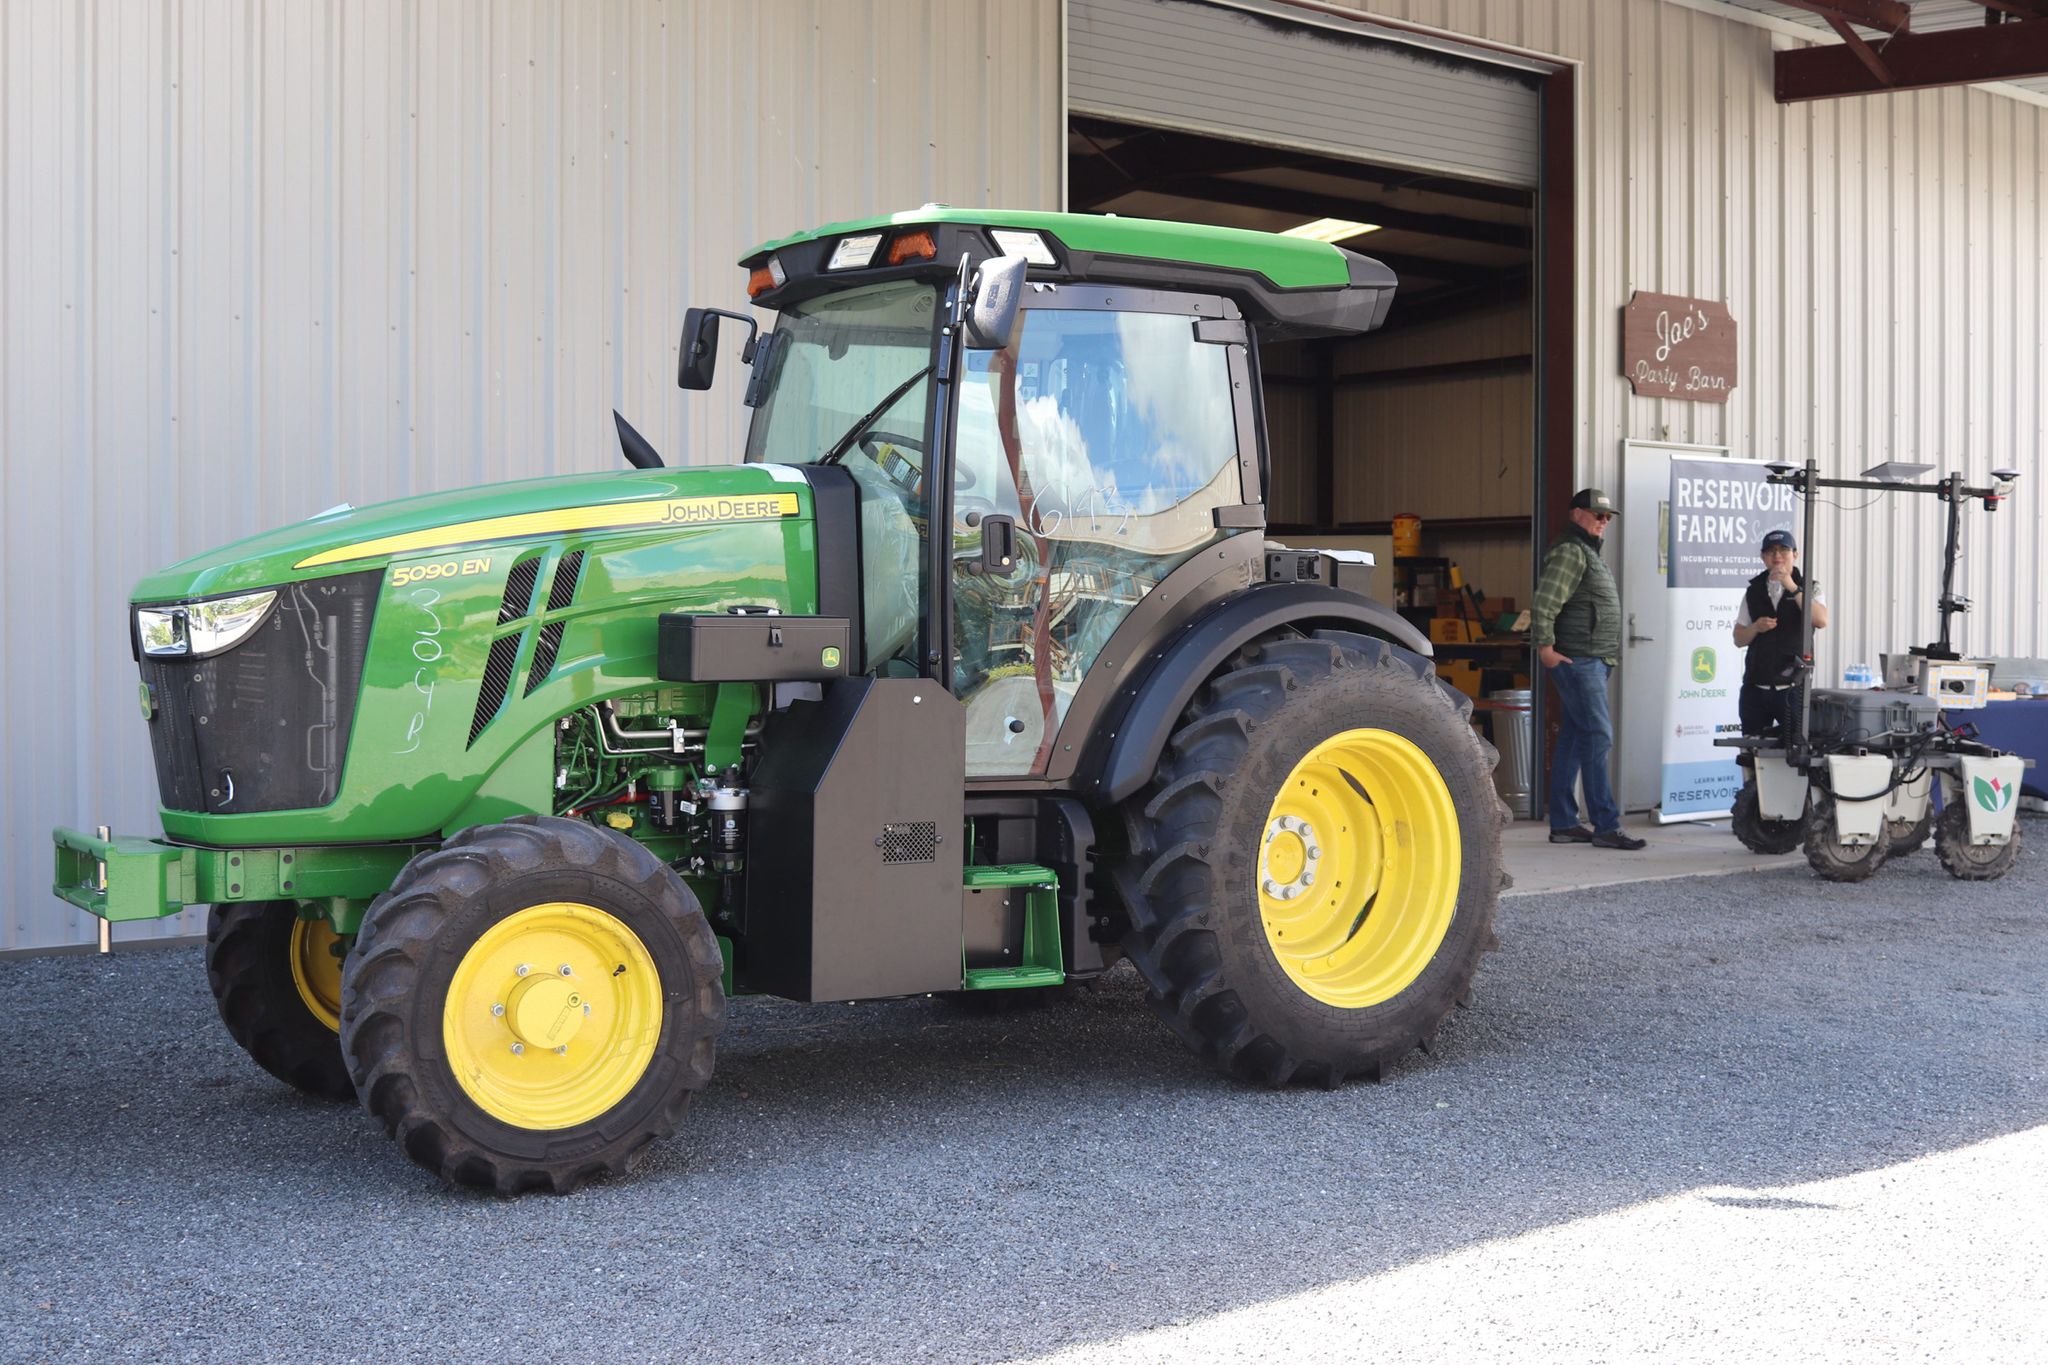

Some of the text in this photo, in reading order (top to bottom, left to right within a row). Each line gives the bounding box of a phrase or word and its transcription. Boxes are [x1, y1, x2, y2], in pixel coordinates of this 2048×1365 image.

[1656, 304, 1709, 362] Joe's
[1636, 360, 1725, 393] Party Barn
[1677, 477, 1794, 512] RESERVOIR
[662, 500, 780, 521] JOHN DEERE
[1677, 514, 1748, 544] FARMS
[391, 557, 492, 588] 5090 EN
[1705, 567, 1719, 575] FOR
[1721, 567, 1739, 576] WINE
[1686, 619, 1712, 631] OUR
[1678, 688, 1727, 699] JOHN DEERE
[1694, 775, 1735, 784] LEARN MORE
